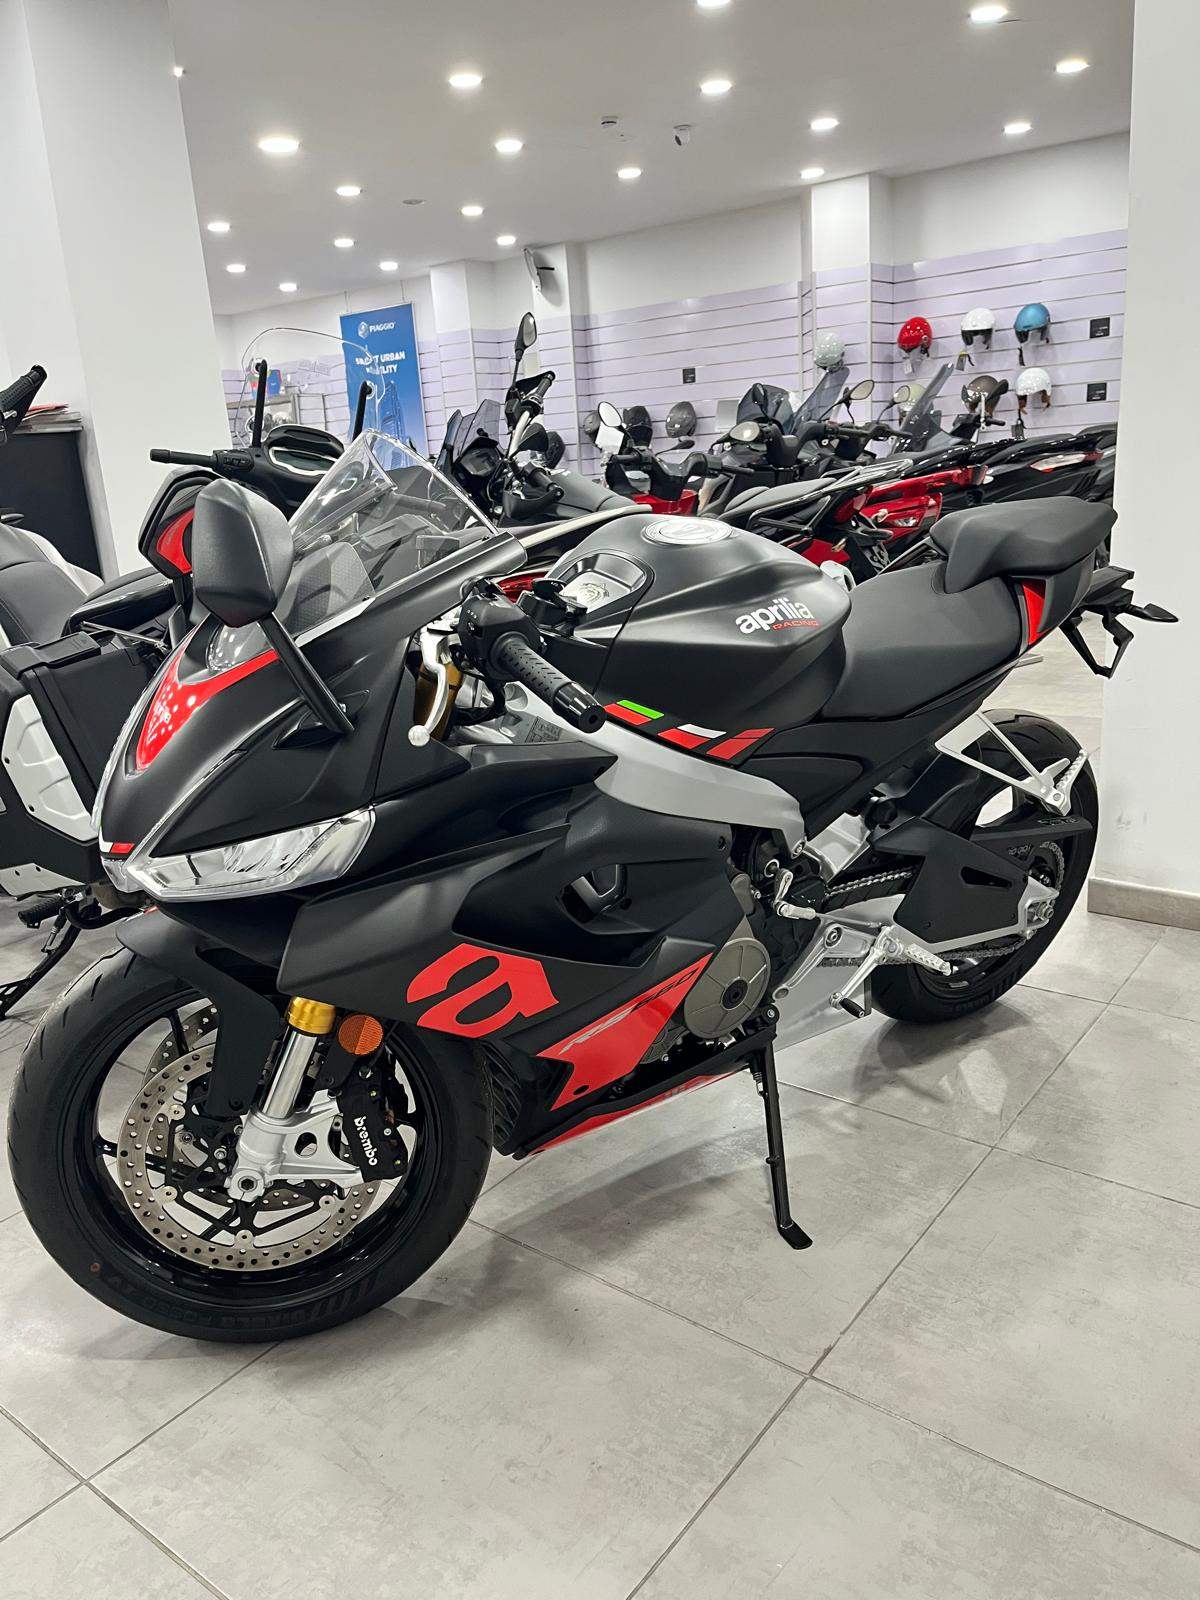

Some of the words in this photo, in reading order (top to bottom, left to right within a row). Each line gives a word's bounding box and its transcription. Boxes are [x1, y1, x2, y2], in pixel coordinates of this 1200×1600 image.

[369, 322, 395, 332] PIAGGIO
[380, 351, 405, 362] URBAN
[735, 597, 815, 634] aprilia
[771, 620, 820, 630] RACING
[630, 967, 700, 1013] 660
[354, 1115, 378, 1166] brembo
